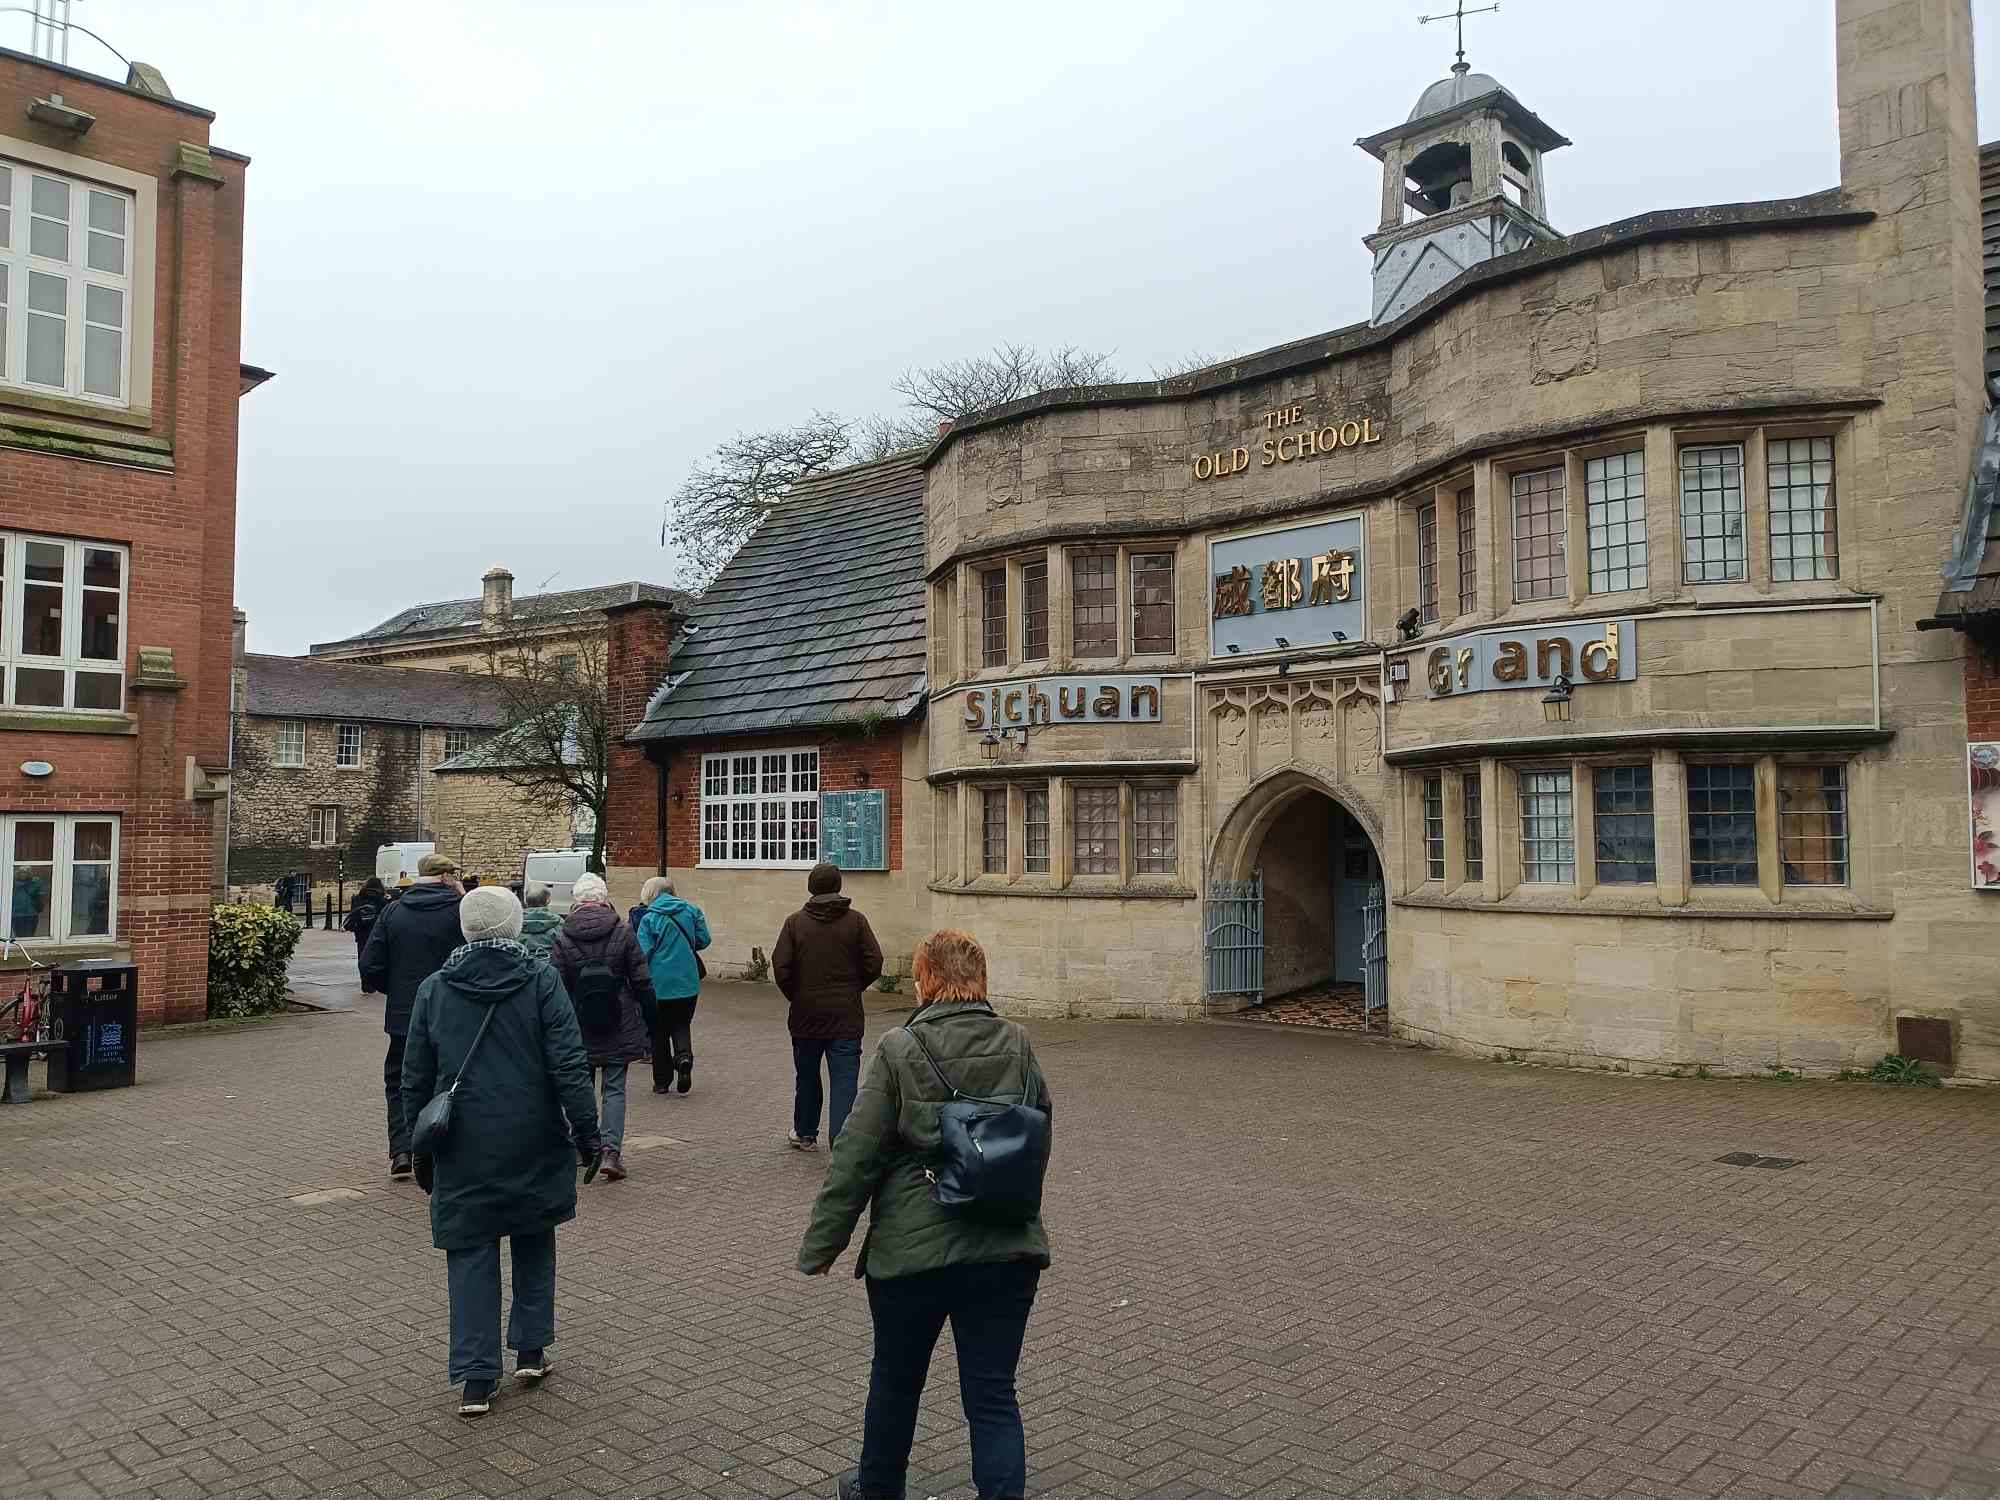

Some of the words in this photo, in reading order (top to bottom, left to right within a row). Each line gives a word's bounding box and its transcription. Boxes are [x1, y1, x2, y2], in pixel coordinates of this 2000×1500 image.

[1263, 405, 1304, 430] THE
[1194, 446, 1250, 480] OLD
[1261, 416, 1381, 466] SCHOOL
